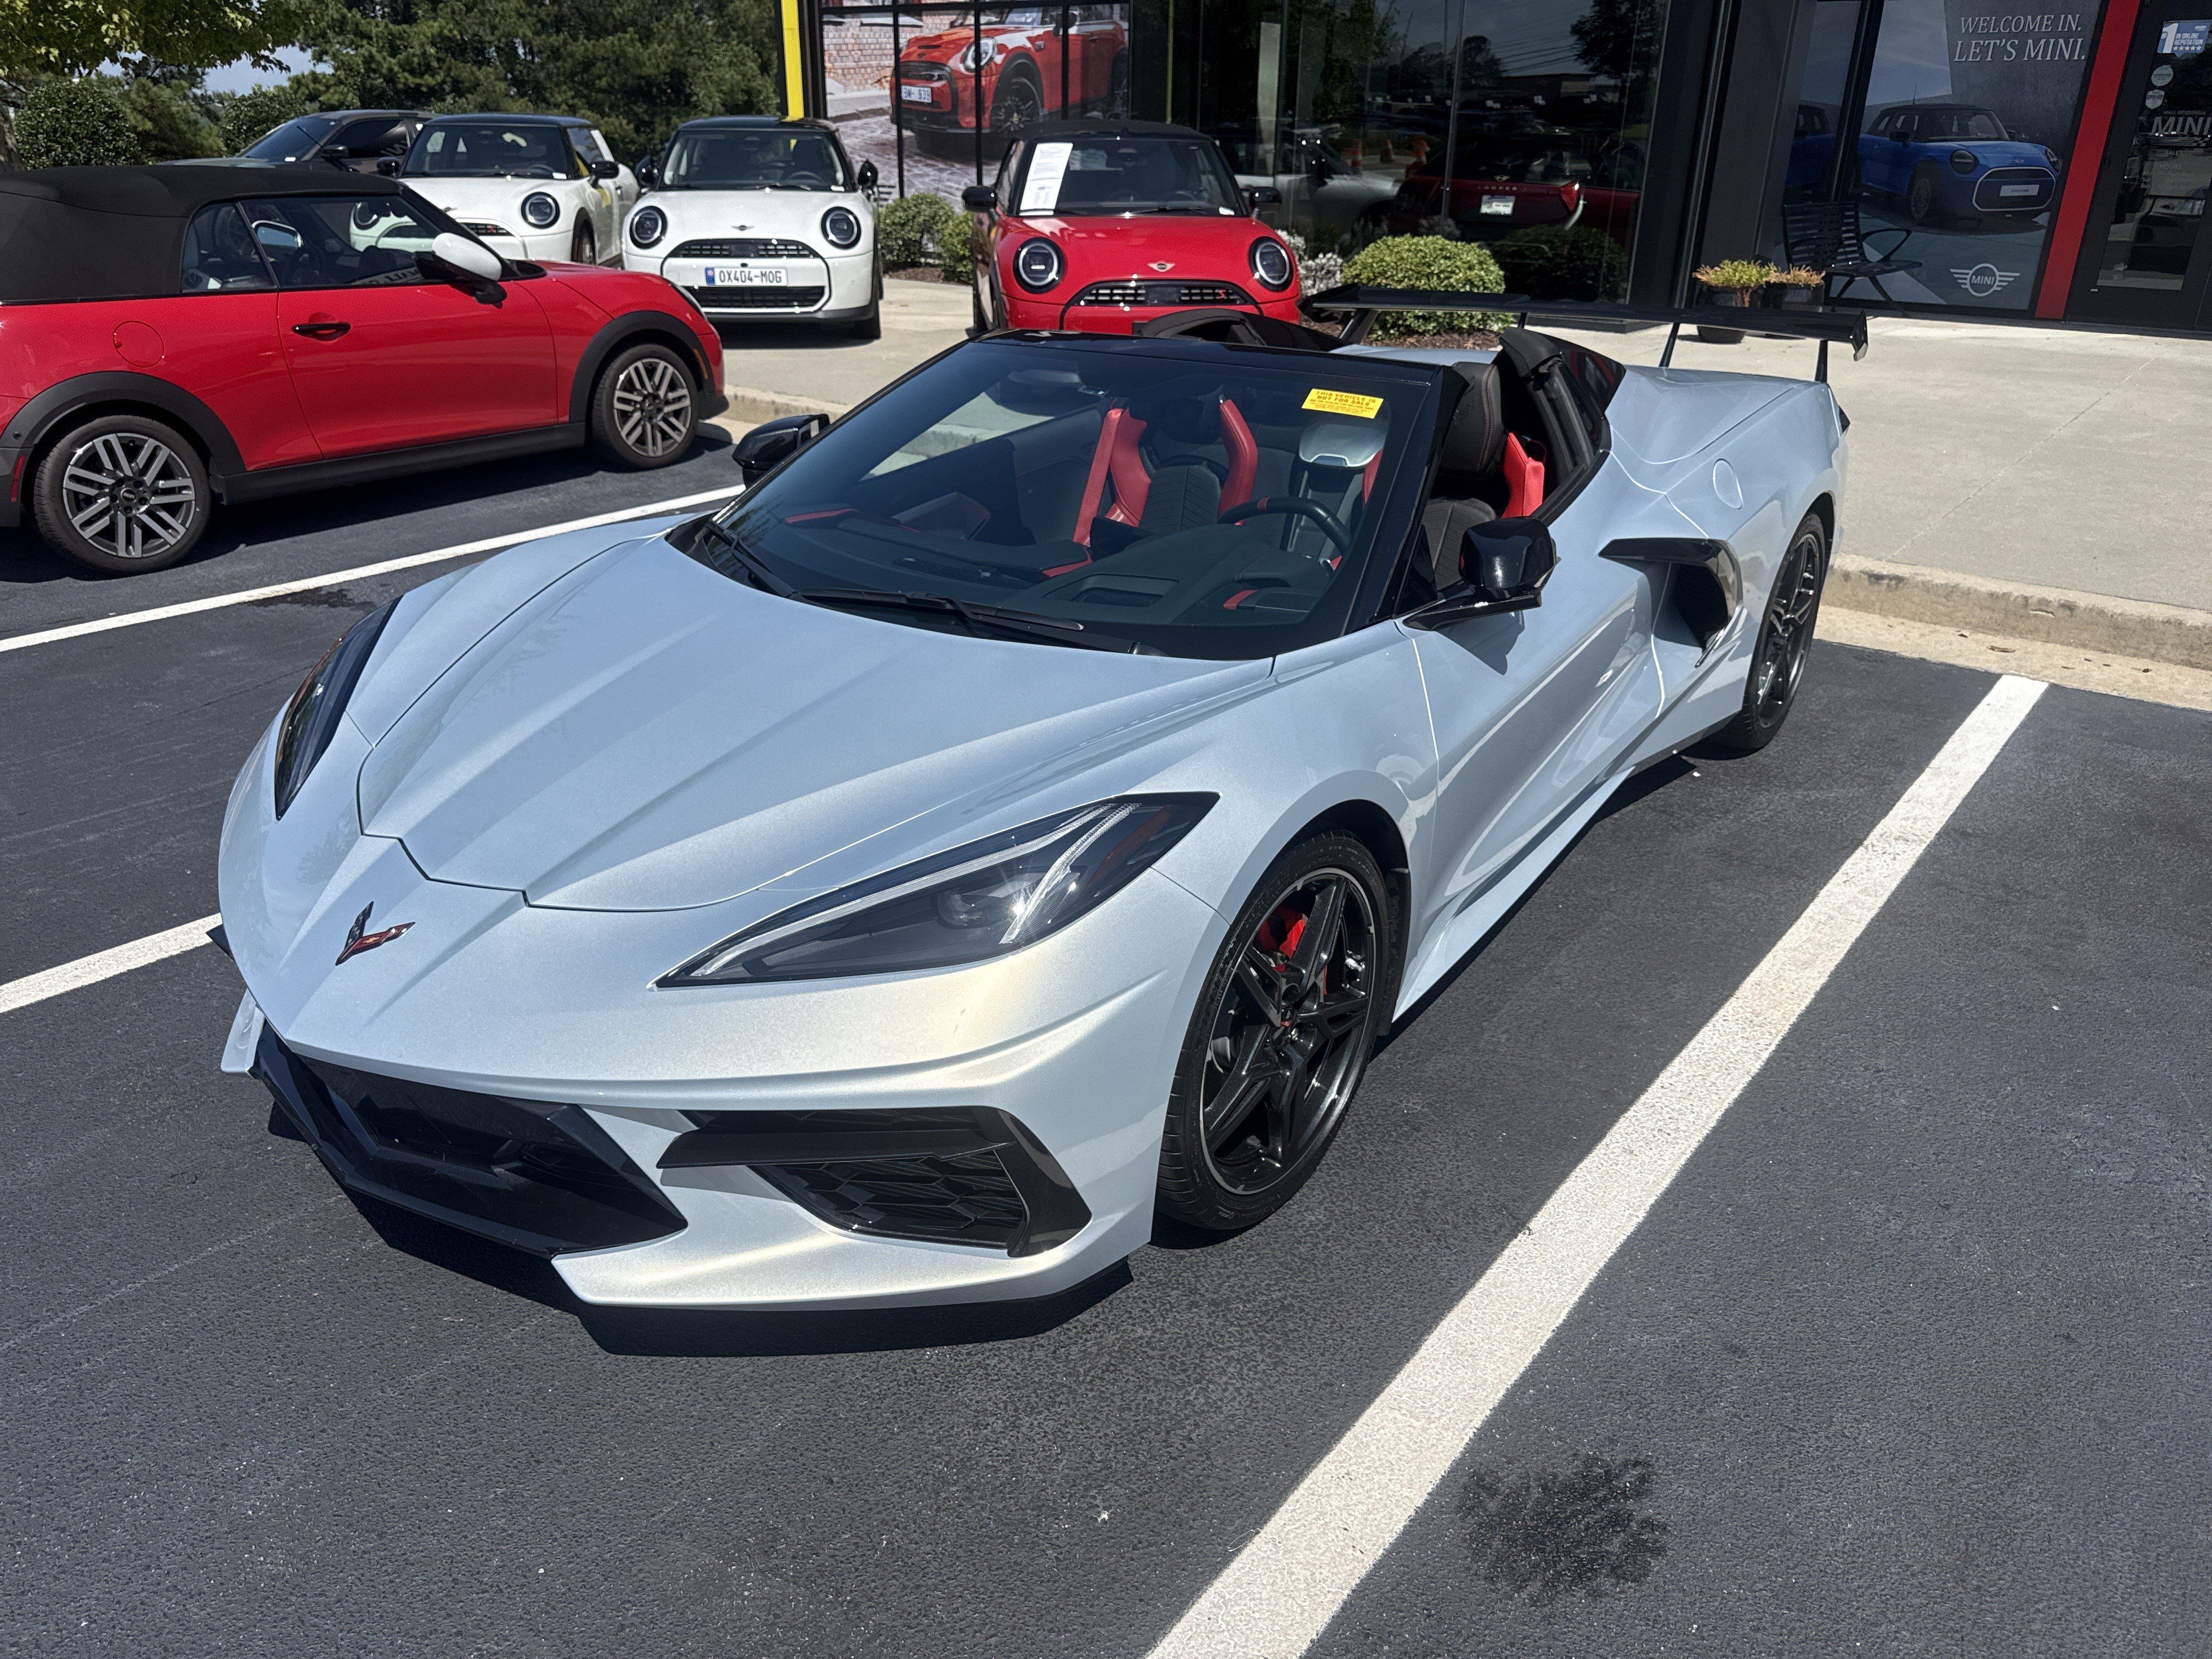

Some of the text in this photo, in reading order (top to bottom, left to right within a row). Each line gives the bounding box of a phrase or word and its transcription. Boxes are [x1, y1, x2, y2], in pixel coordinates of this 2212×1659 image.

[1961, 14, 2082, 33] WELCOME IN.
[1953, 38, 2085, 61] LET'S MINI.
[2151, 116, 2211, 135] MINI
[1971, 275, 1995, 285] MINI
